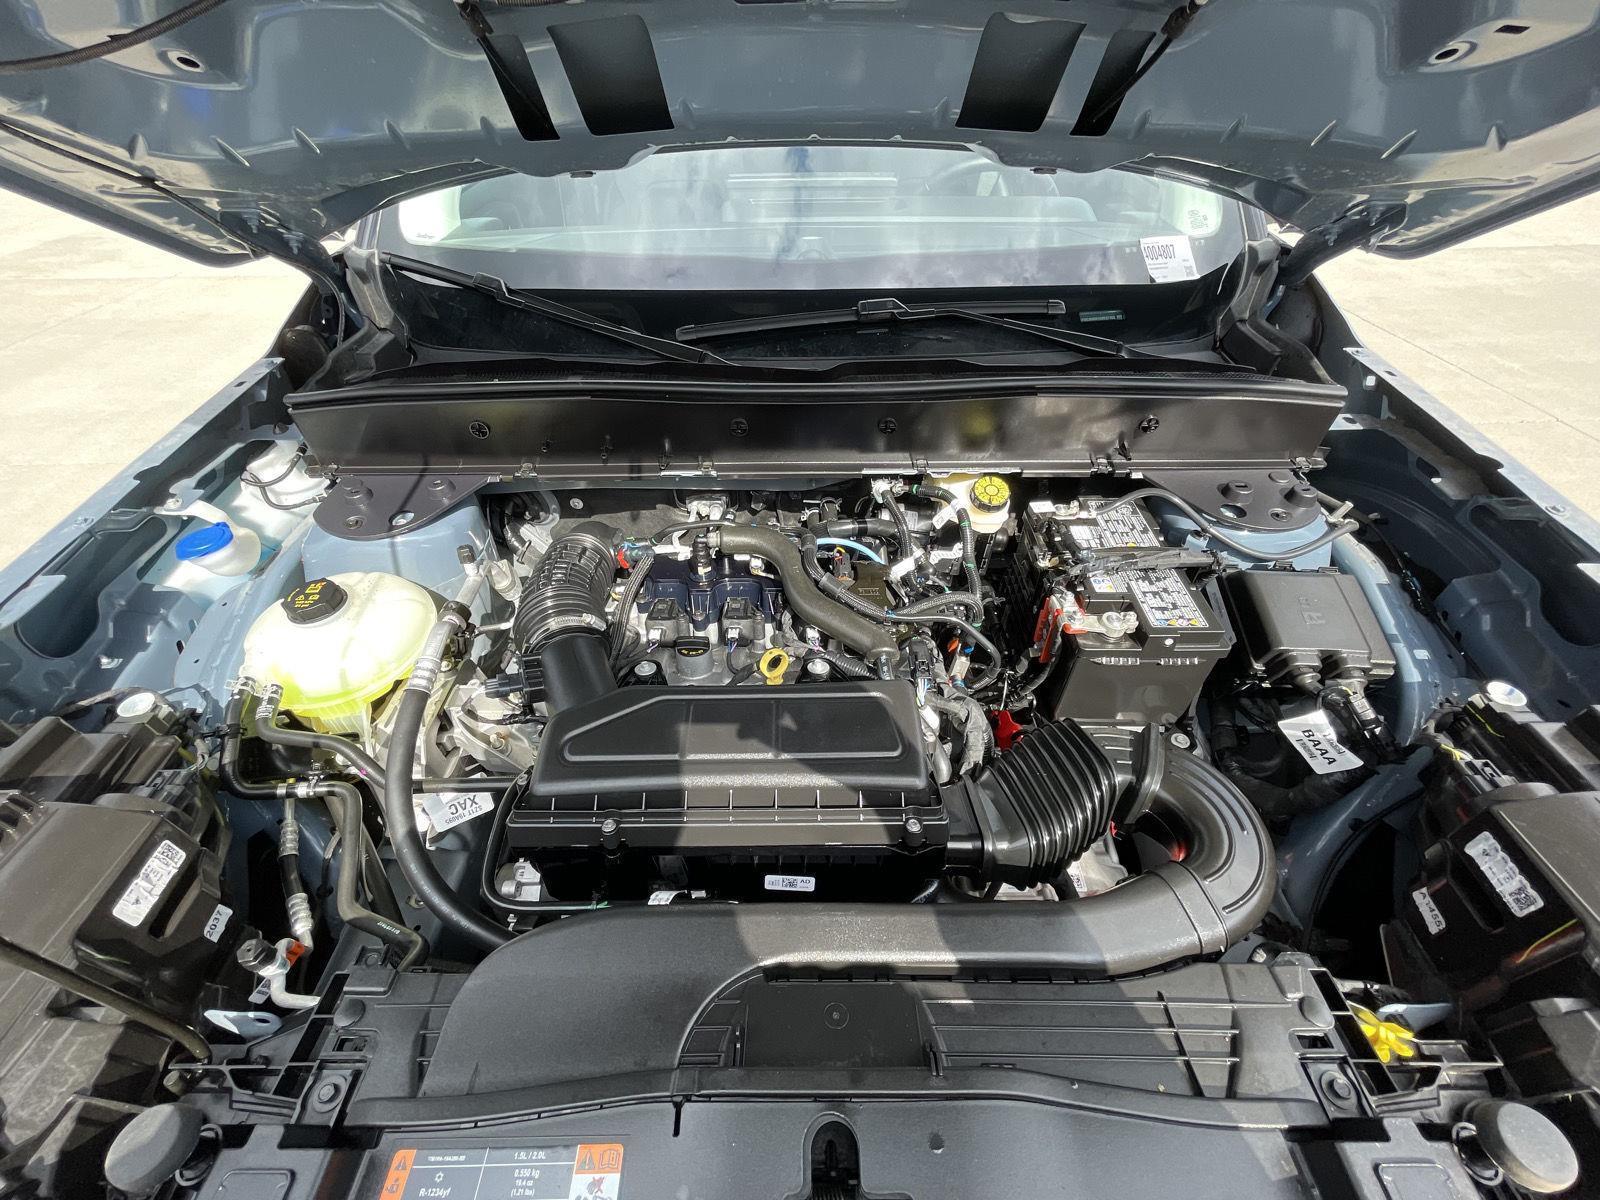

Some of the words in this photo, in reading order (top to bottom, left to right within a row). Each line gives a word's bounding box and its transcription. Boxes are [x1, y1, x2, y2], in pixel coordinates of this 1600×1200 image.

[1301, 729, 1337, 765] BAAA
[448, 795, 479, 816] XAC
[532, 1151, 546, 1160] 2.0L
[418, 1187, 452, 1199] R-1234yf
